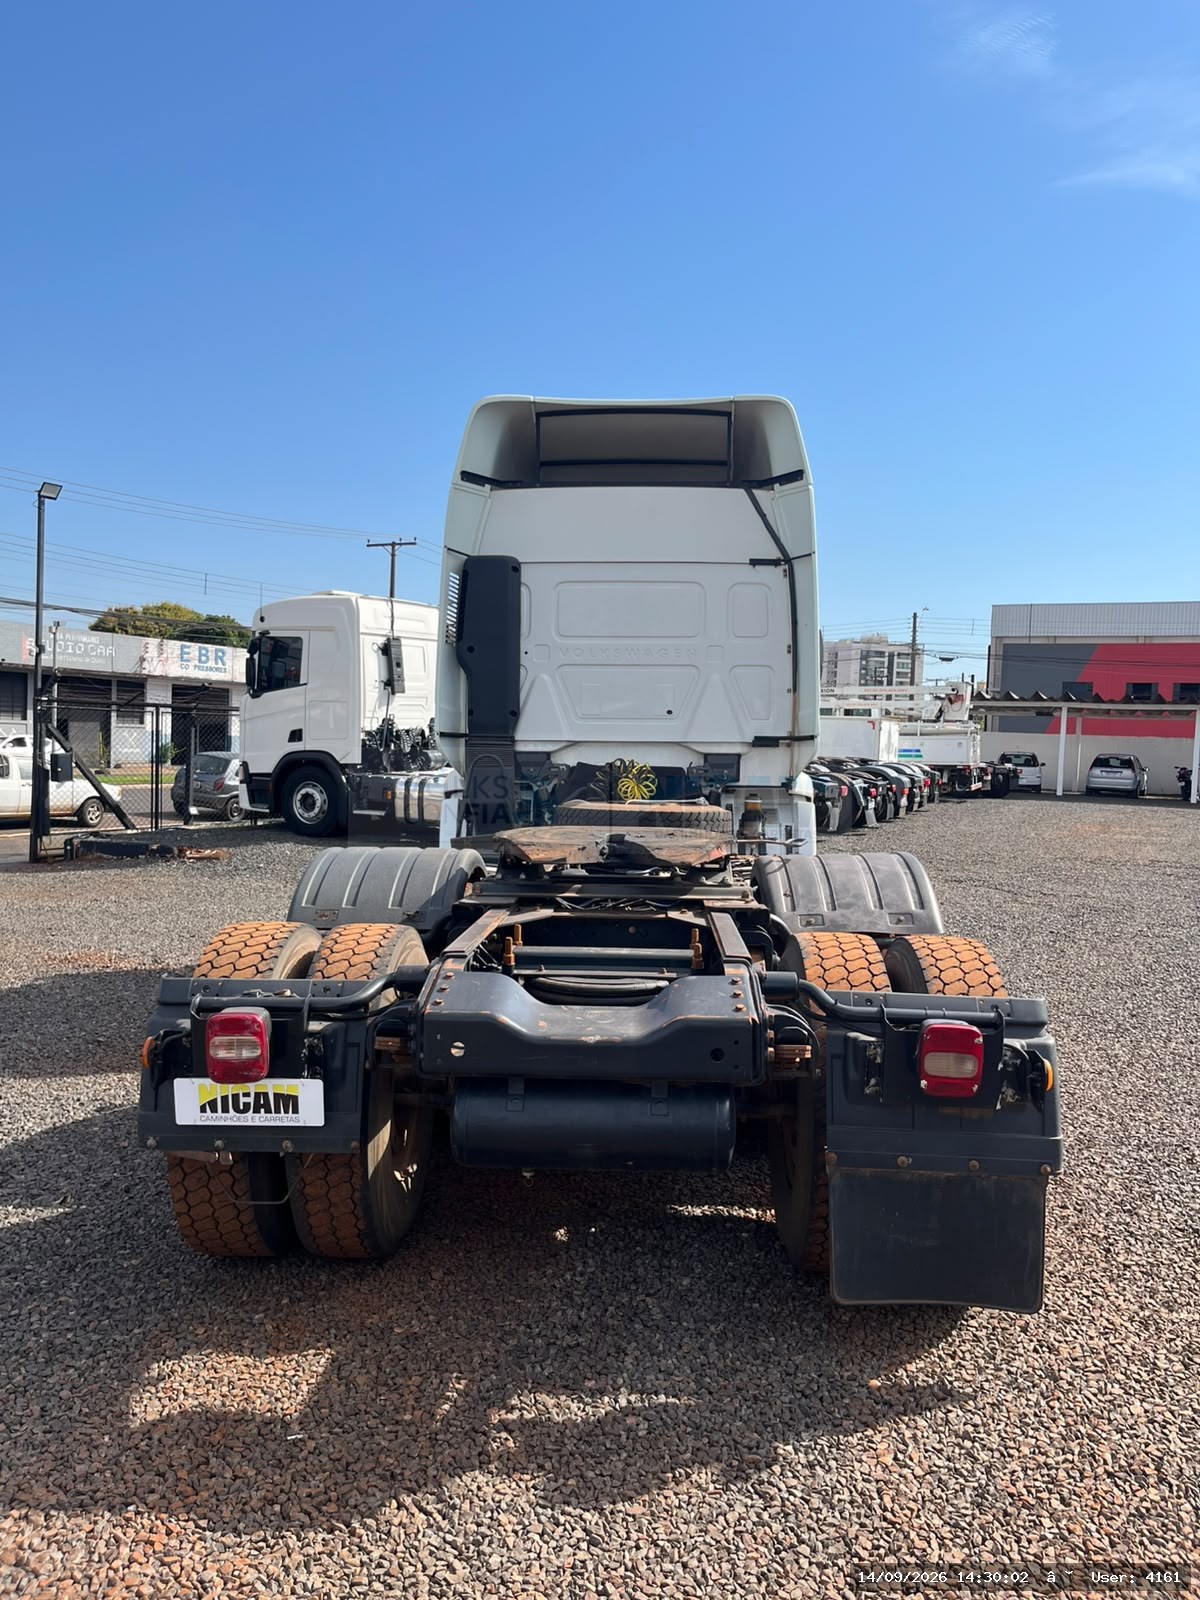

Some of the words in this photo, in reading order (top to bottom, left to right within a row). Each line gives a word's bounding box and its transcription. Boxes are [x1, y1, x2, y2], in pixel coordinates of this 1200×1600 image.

[179, 643, 227, 666] EBR
[559, 647, 697, 658] VOLKSWAGEN
[198, 1083, 300, 1114] NICAM
[199, 1114, 249, 1123] CAMINHÕES
[251, 1115, 257, 1123] E
[258, 1115, 300, 1123] CARRETAS
